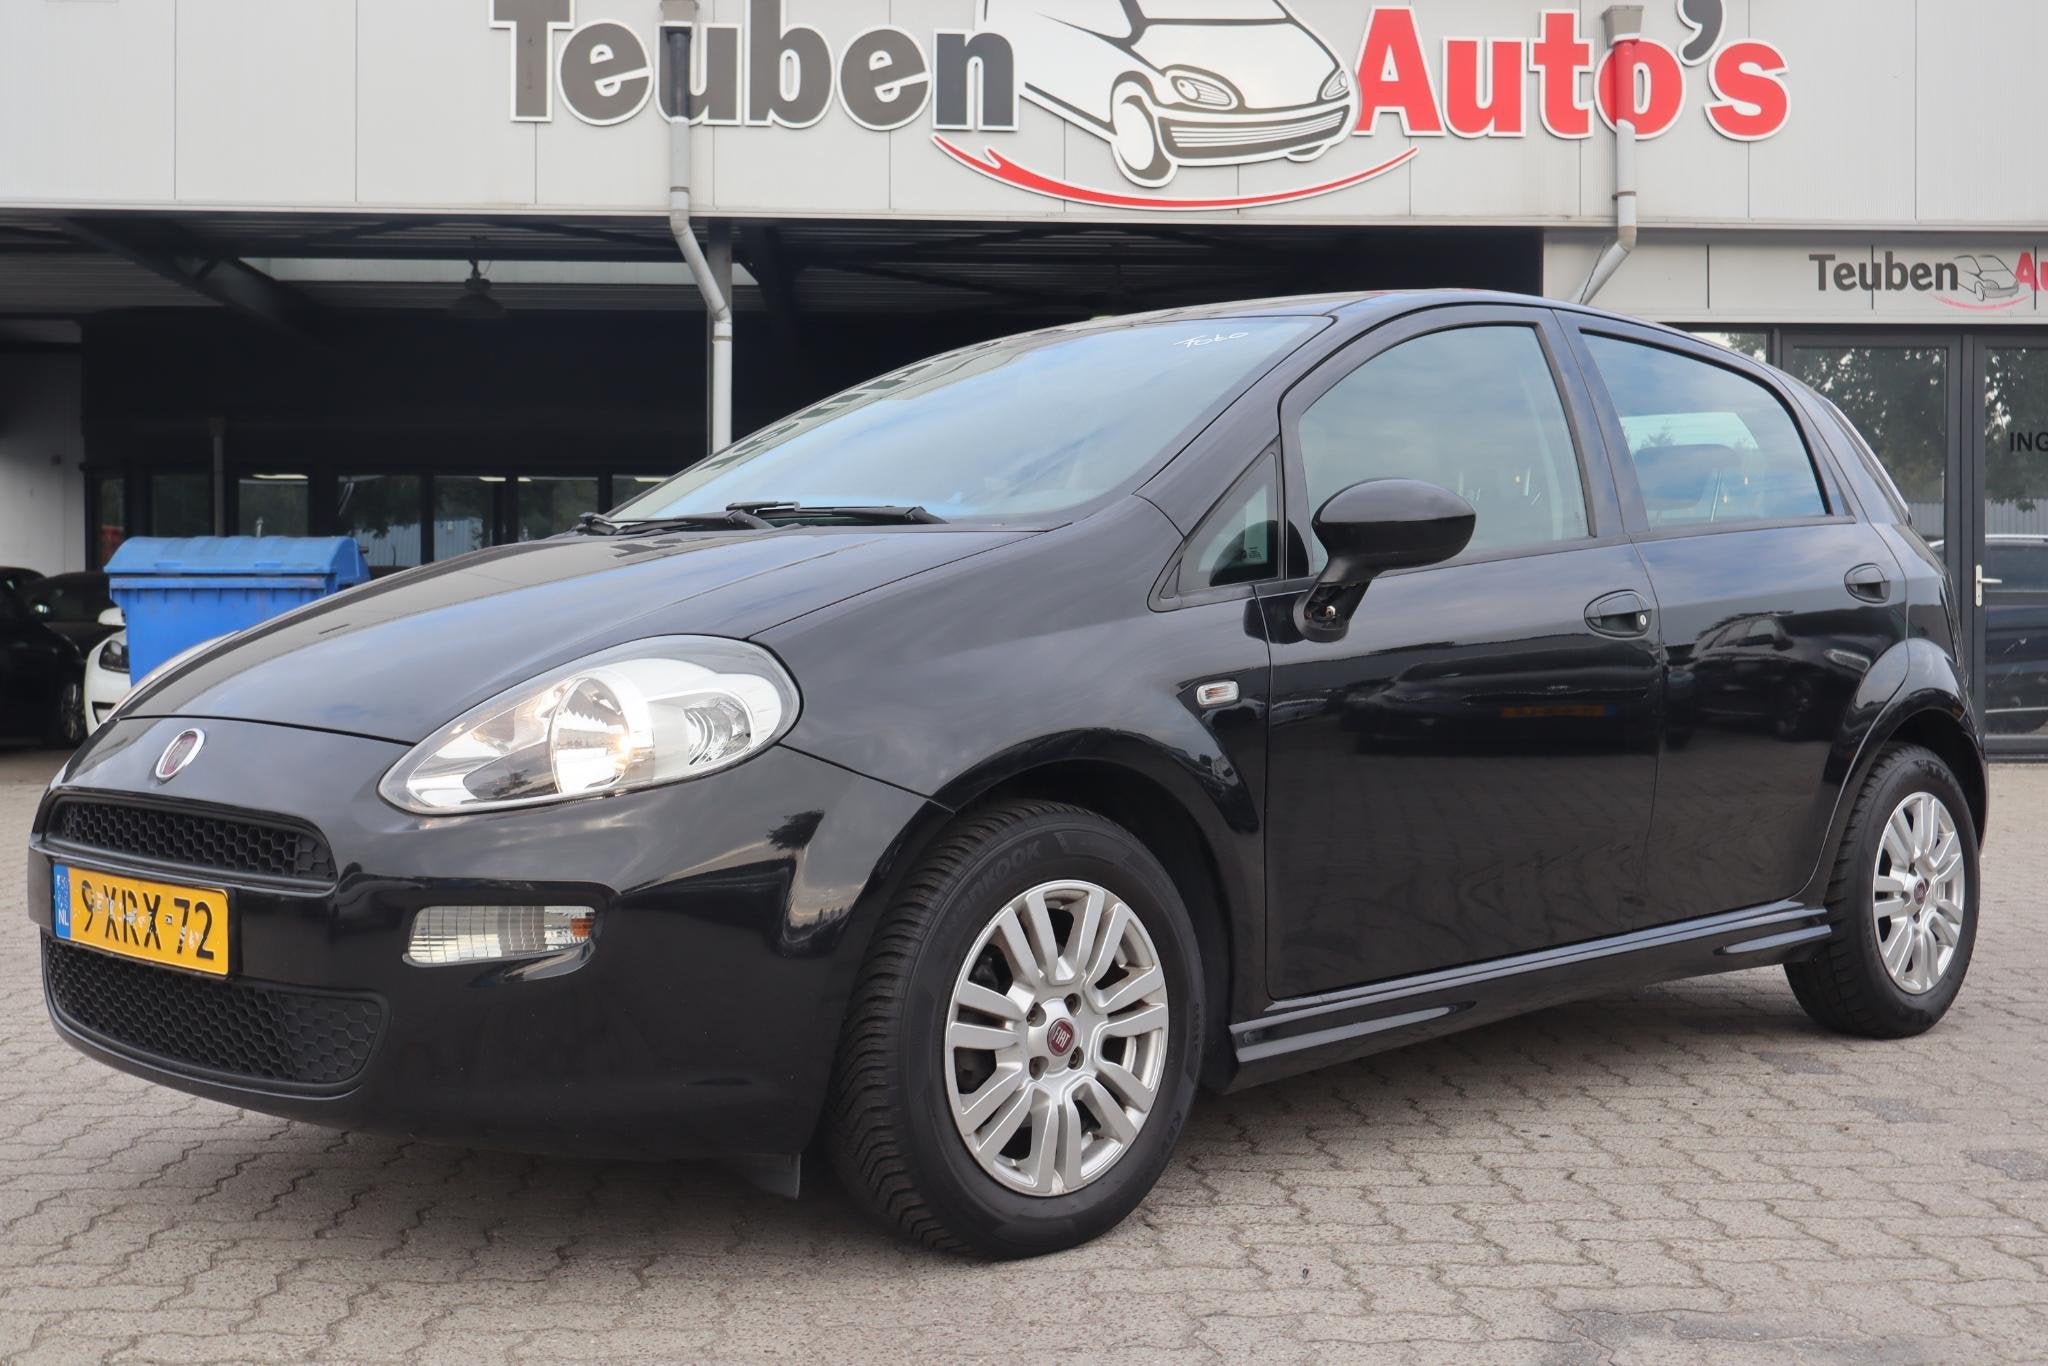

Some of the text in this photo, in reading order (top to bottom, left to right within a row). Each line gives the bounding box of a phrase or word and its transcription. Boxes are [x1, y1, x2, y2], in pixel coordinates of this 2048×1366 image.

[491, 0, 1788, 139] Teuben Auto's
[1809, 251, 1958, 291] Teuben
[58, 908, 70, 927] NL
[81, 879, 215, 961] 9-XRX-72
[1053, 1026, 1071, 1048] FIAT
